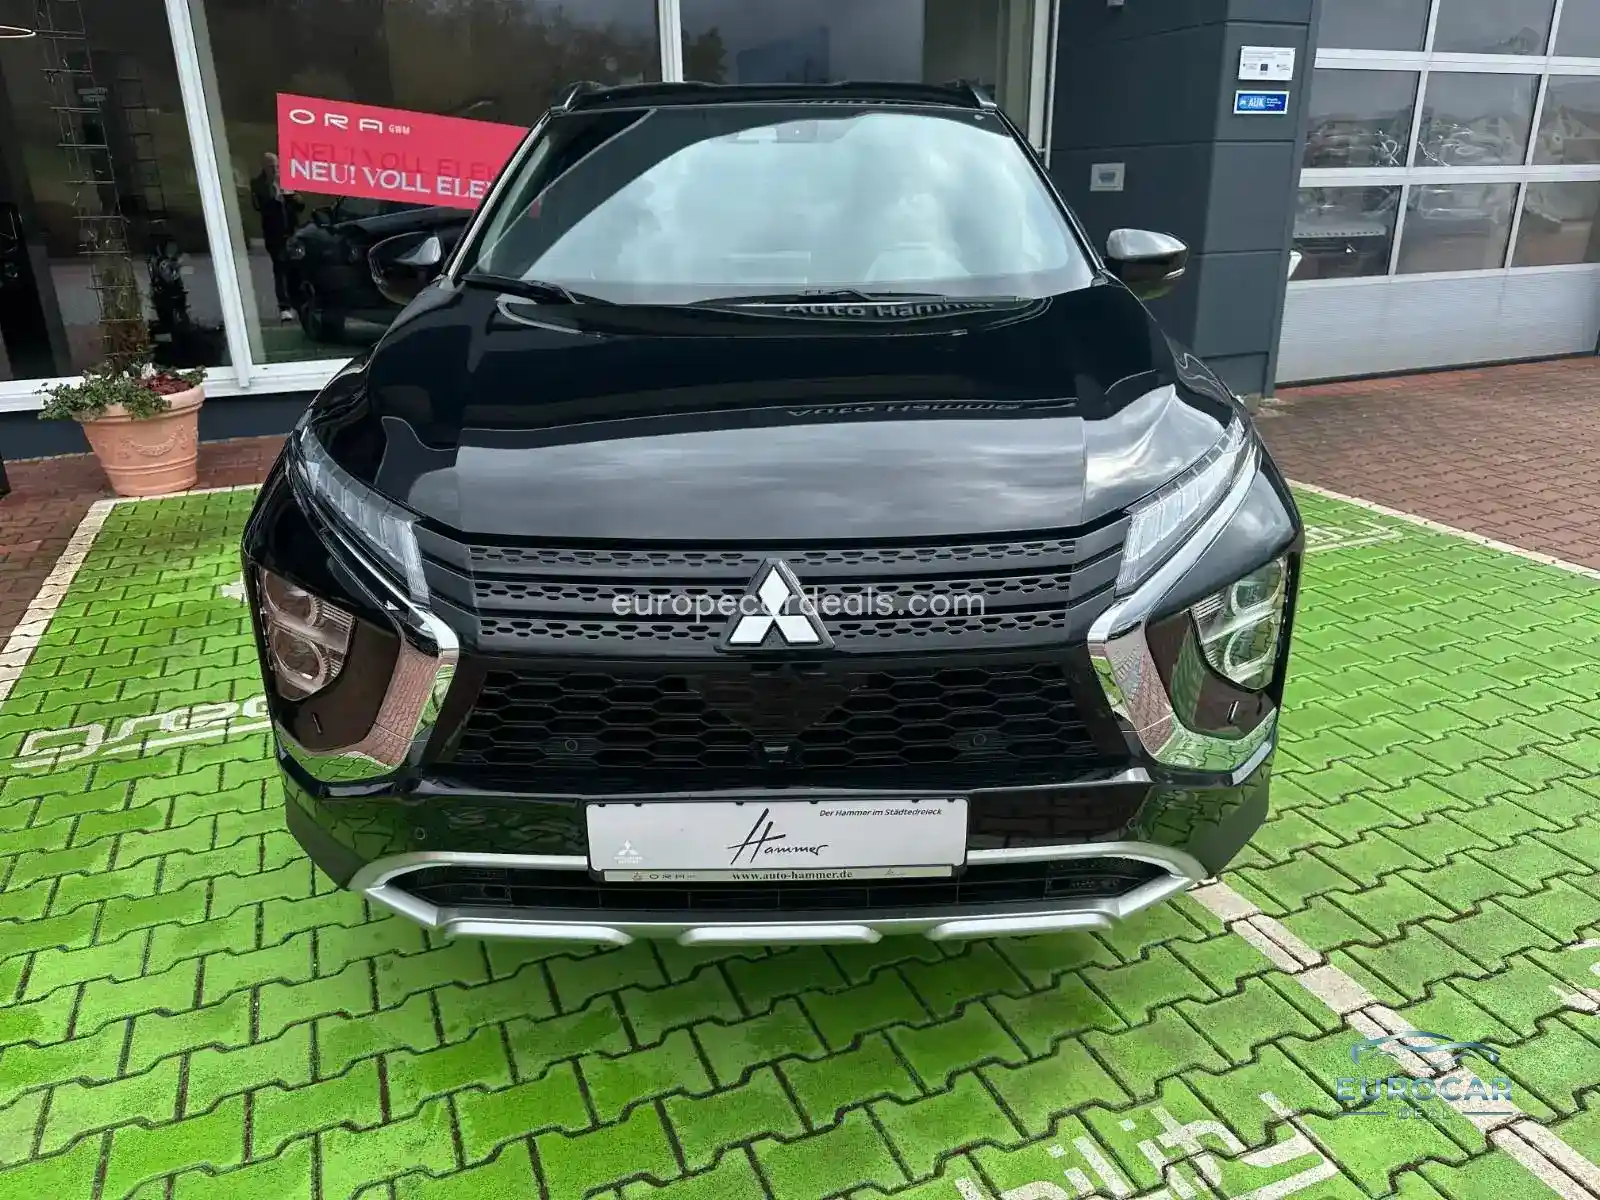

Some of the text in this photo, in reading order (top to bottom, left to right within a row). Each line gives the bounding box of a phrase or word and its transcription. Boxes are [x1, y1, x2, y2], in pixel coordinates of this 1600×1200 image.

[289, 109, 383, 134] ORA
[290, 159, 356, 186] NEU!
[362, 166, 432, 195] VOLL
[819, 809, 834, 817] Der
[835, 808, 871, 817] Hammer
[885, 808, 942, 816] Städtedreieck
[727, 807, 829, 865] Hammer
[732, 869, 853, 880] www.auto-hammer.de
